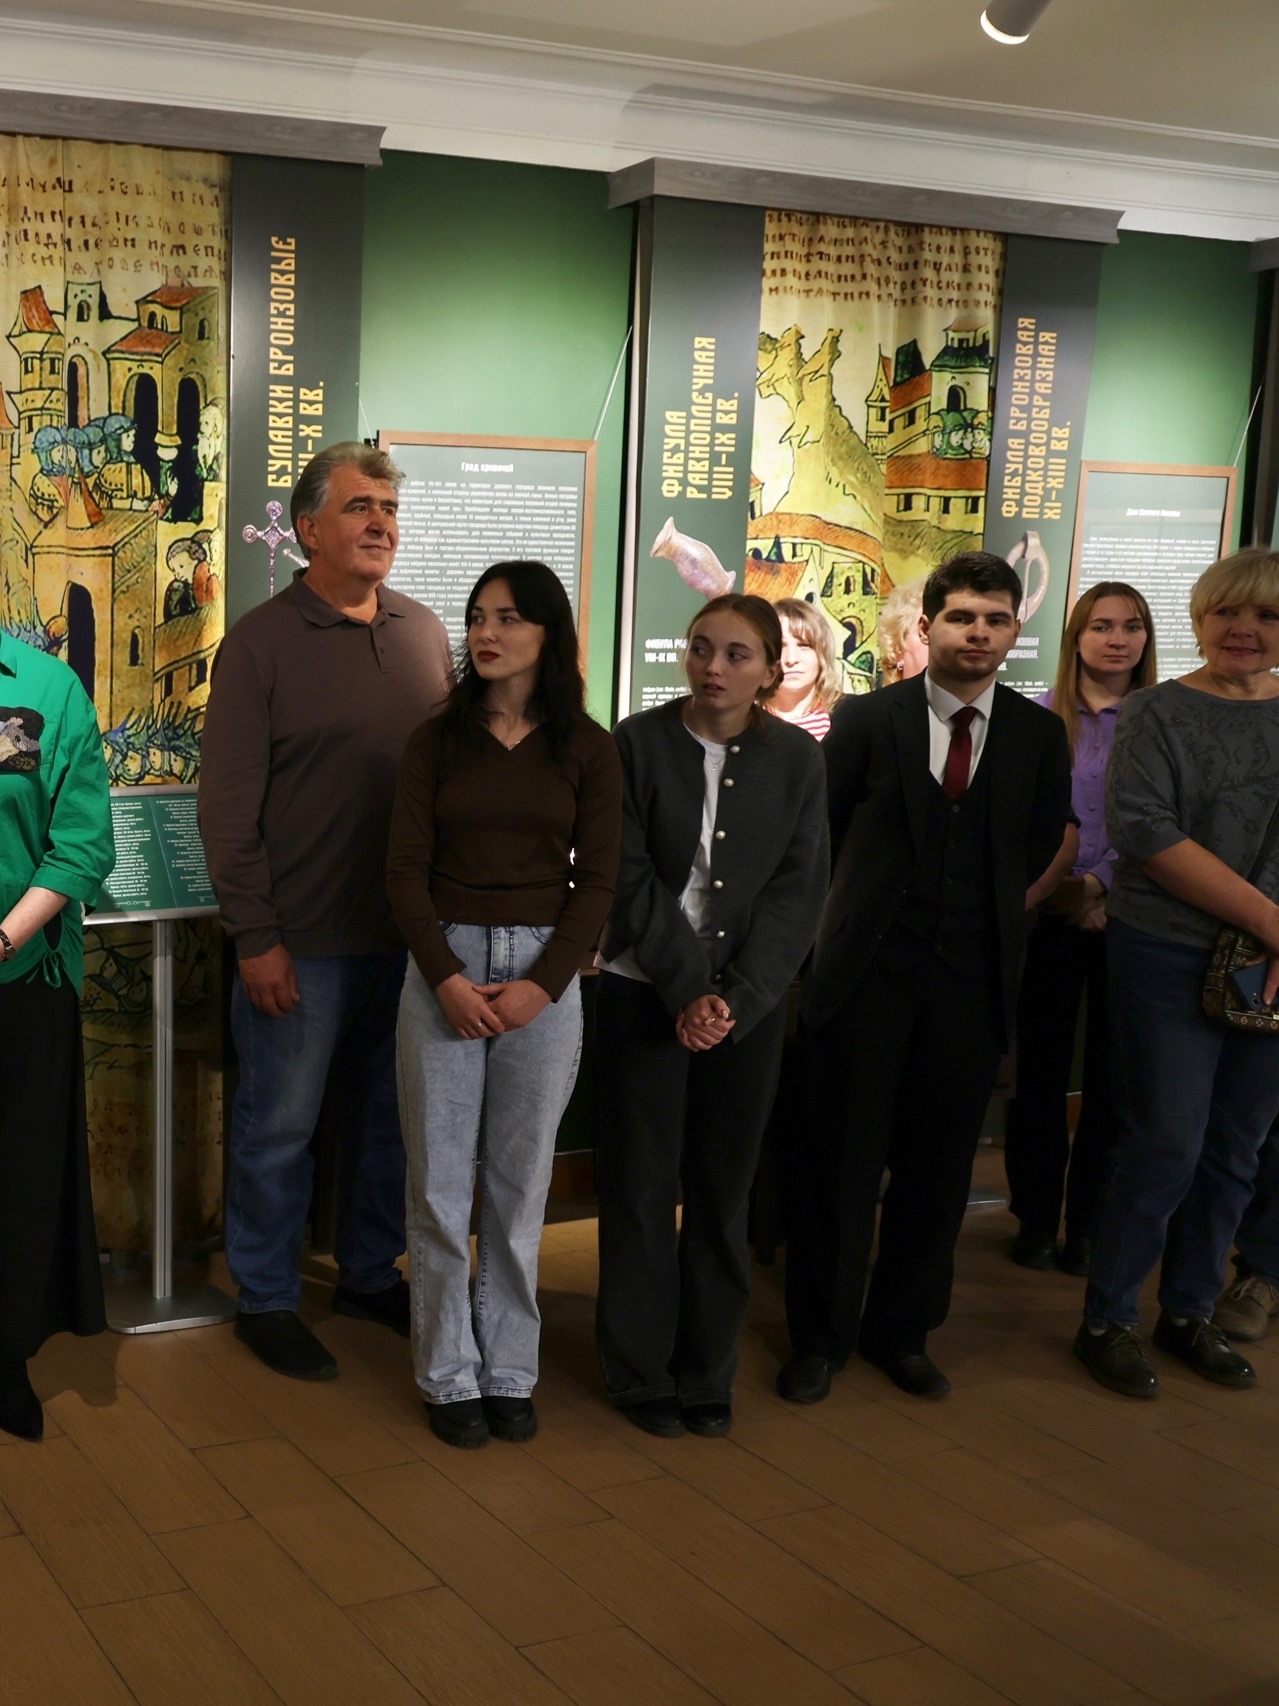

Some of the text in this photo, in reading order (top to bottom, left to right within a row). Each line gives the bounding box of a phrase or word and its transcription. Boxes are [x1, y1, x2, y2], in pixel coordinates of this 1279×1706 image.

[268, 236, 296, 488] БУЛАВКИ БРОНЗОВЫЕ
[686, 336, 716, 499] РАВНОПЛЕЧНАЯ
[715, 392, 739, 425] ВВ.
[1001, 317, 1037, 519] ФИБУЛА БРОНЗОВАЯ
[1021, 331, 1058, 519] ПОДКОВООБРАЗНАЯ
[1050, 421, 1071, 451] ВВ.
[461, 461, 479, 473] Град
[661, 410, 687, 498] ФИБУЛА
[645, 638, 673, 649] ФИБУЛА
